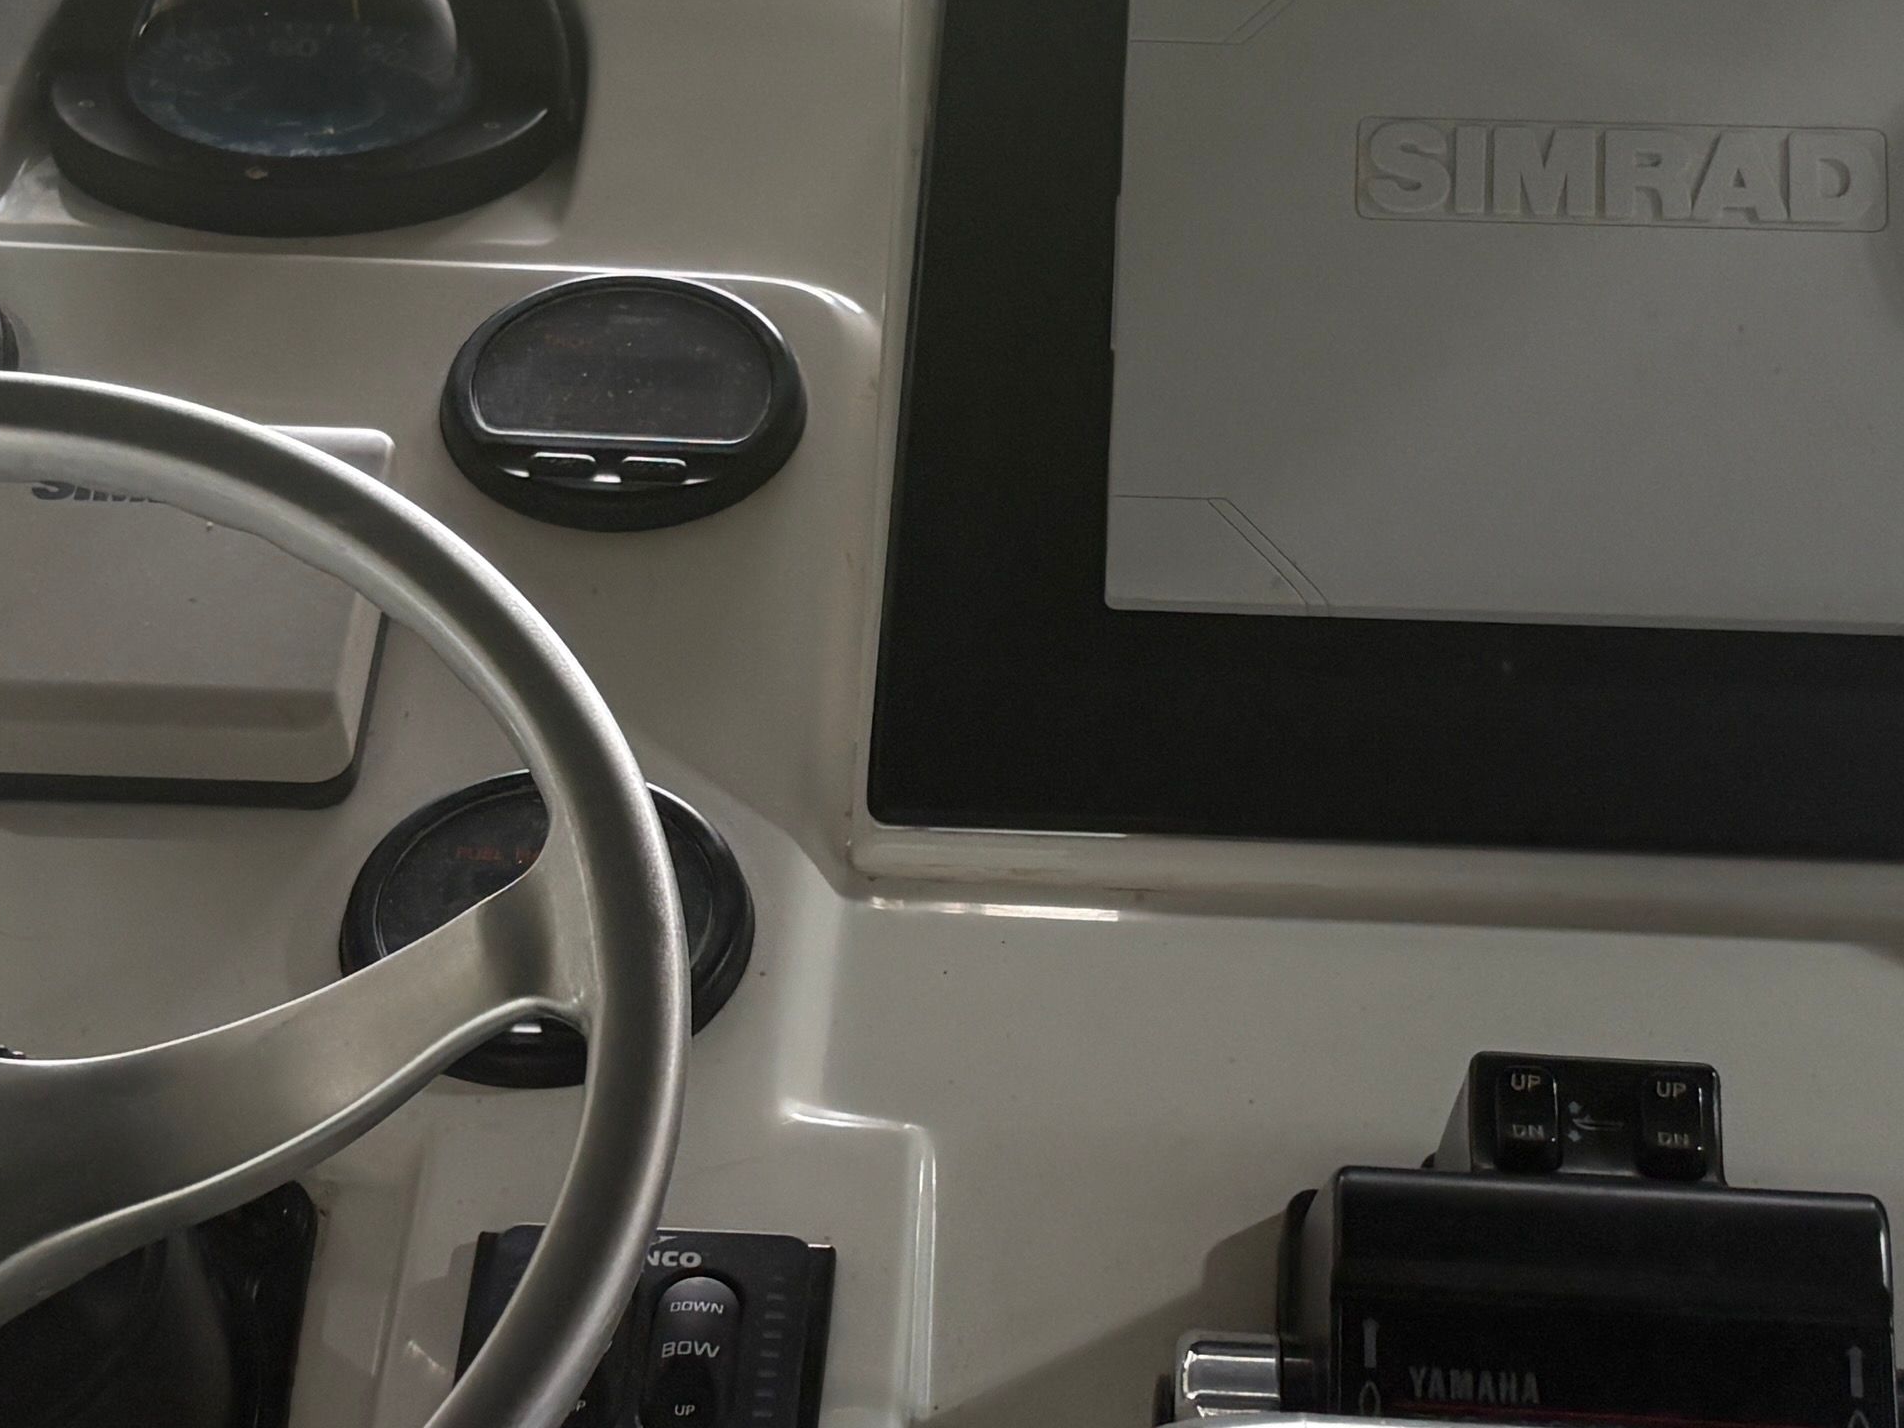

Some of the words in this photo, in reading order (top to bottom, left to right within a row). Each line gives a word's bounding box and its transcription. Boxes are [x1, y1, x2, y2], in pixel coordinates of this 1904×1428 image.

[1366, 120, 1879, 223] SIMRAD
[1511, 1073, 1542, 1092] UP
[1656, 1080, 1687, 1099] UP
[1511, 1124, 1544, 1140] DN
[1657, 1131, 1690, 1147] DN
[647, 1250, 702, 1268] NCO
[670, 1300, 724, 1314] DOWN
[661, 1340, 720, 1359] BOW
[1409, 1366, 1540, 1404] YAMAHA
[674, 1404, 695, 1416] UP
